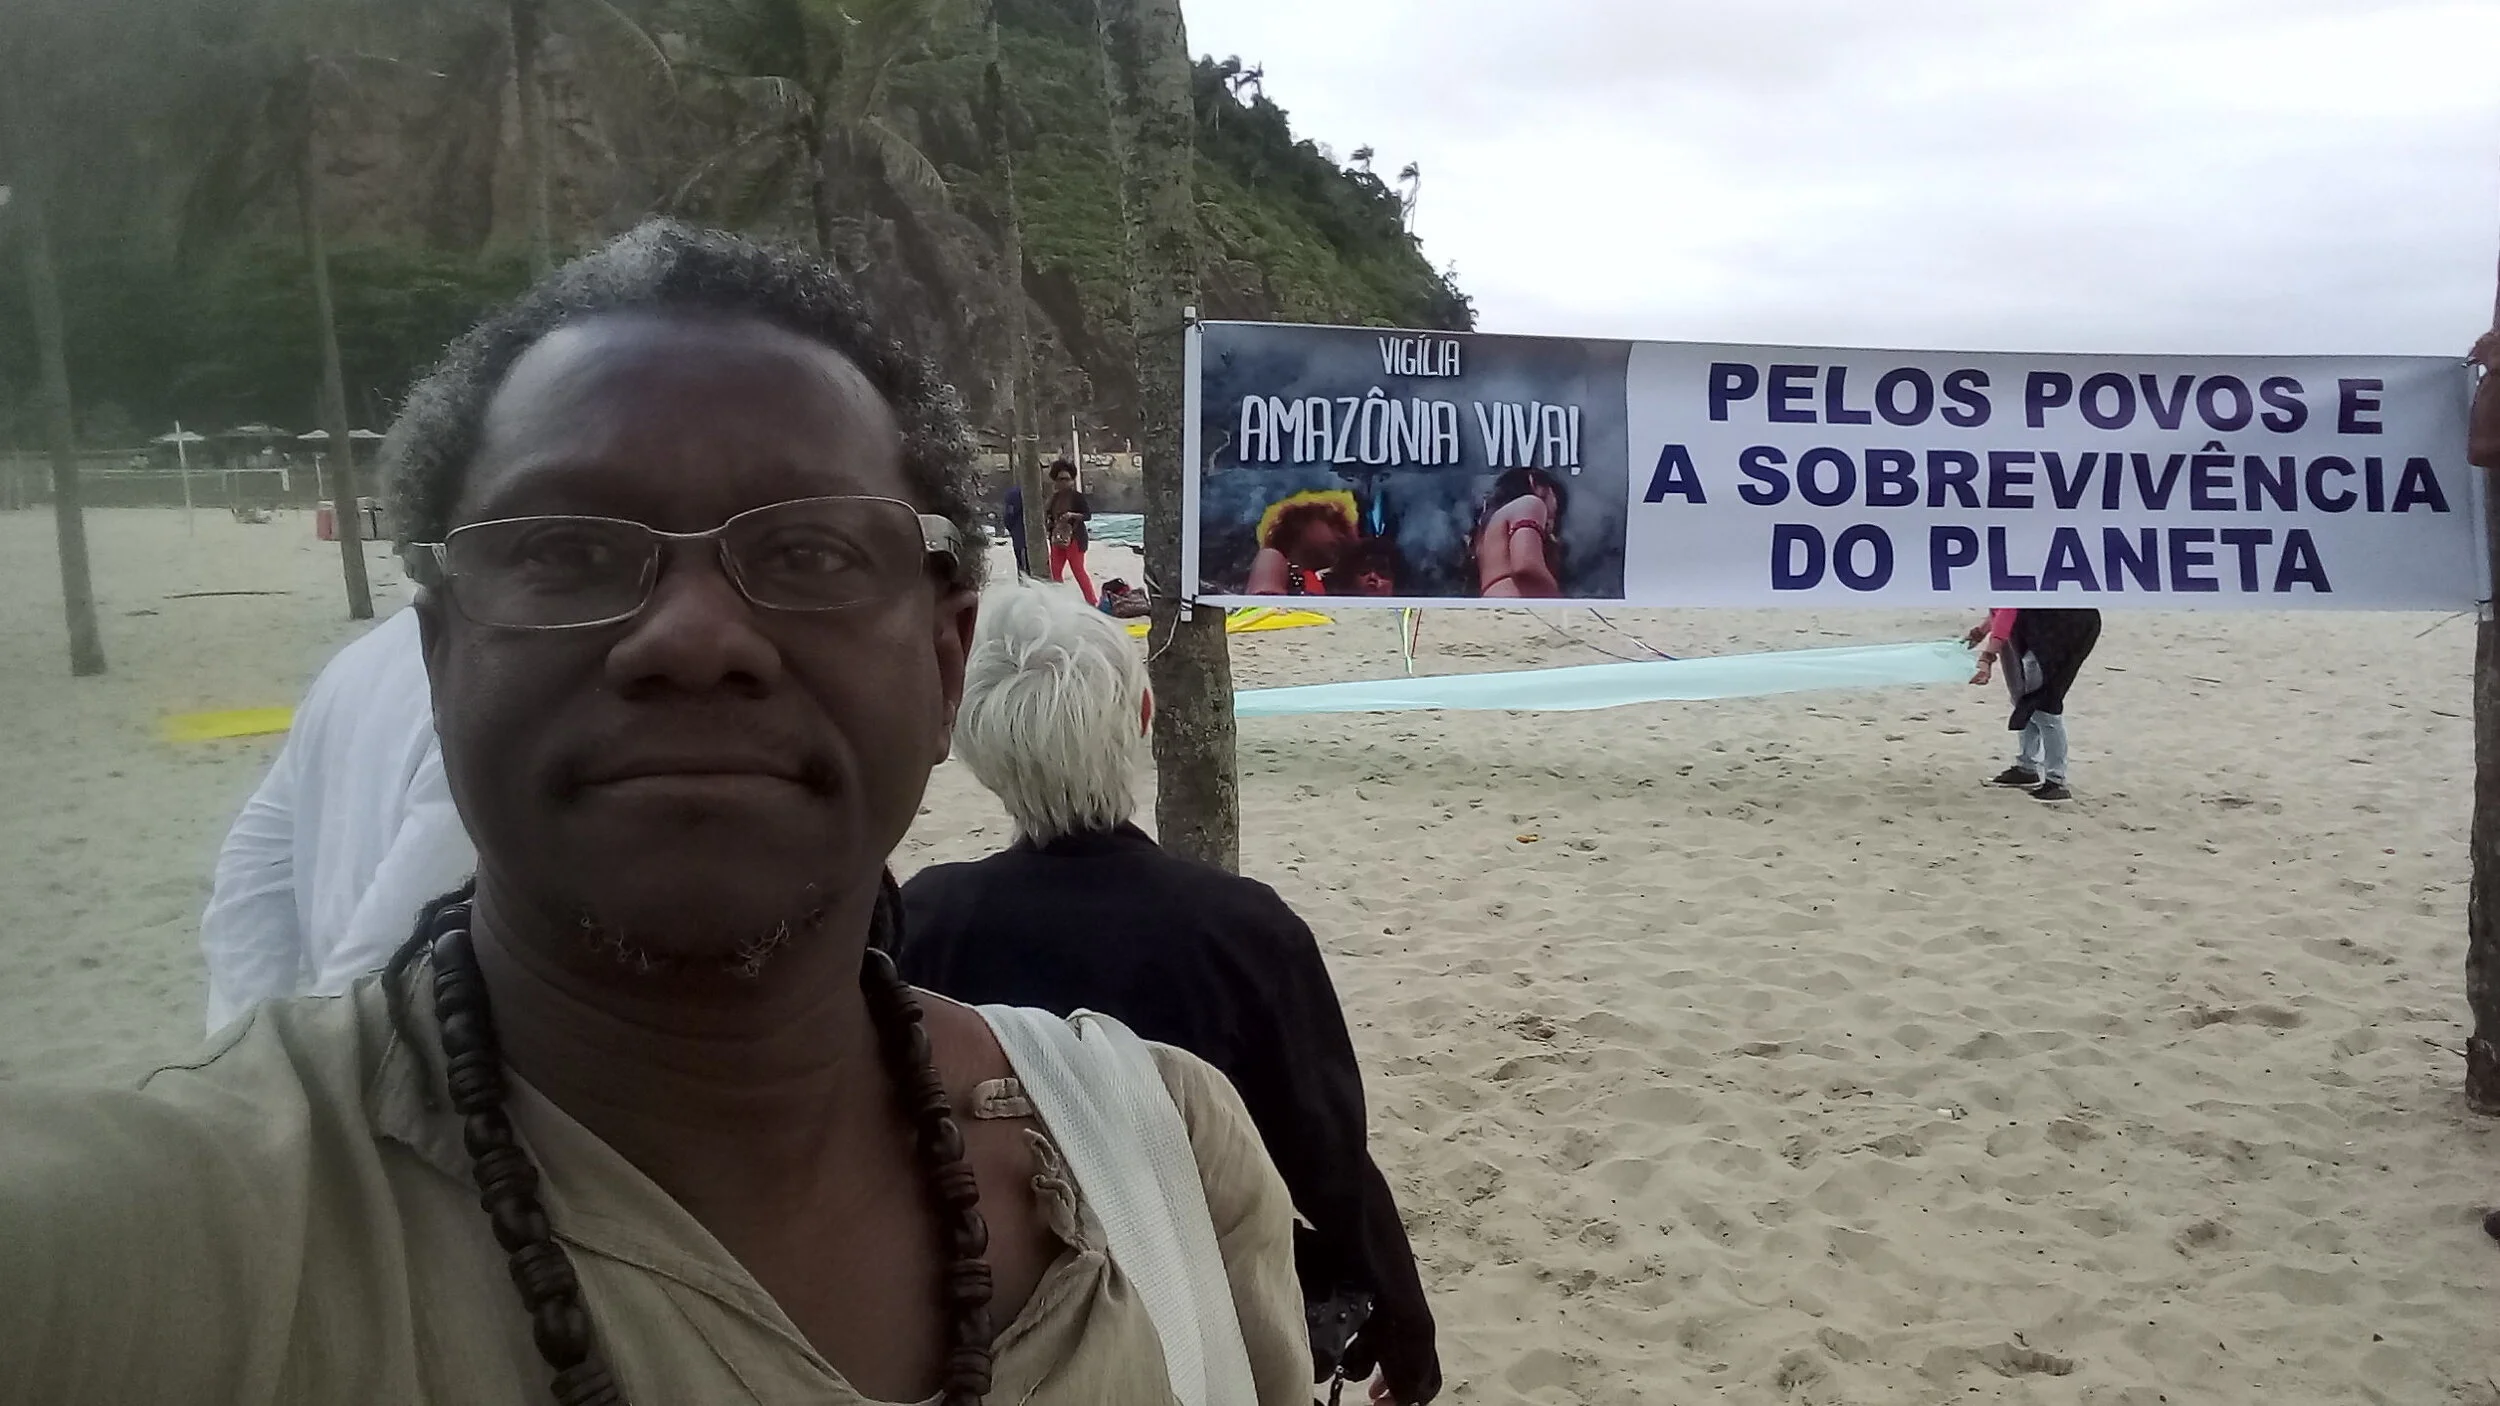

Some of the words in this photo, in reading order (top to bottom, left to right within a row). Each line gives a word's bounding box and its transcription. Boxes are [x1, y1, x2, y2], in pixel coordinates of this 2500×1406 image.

[1379, 333, 1461, 376] VIGÍLIA
[1240, 386, 1459, 465] AMAZÔNIA
[1475, 401, 1581, 475] VIVA!
[1707, 362, 1992, 427] PELOS
[2024, 371, 2309, 434] POVOS
[2338, 378, 2384, 435] E
[1643, 444, 1707, 504] A
[1737, 441, 2451, 513] SOBREVIVÊNCIA
[1771, 523, 1894, 592] DO
[1929, 525, 2333, 593] PLANETA
